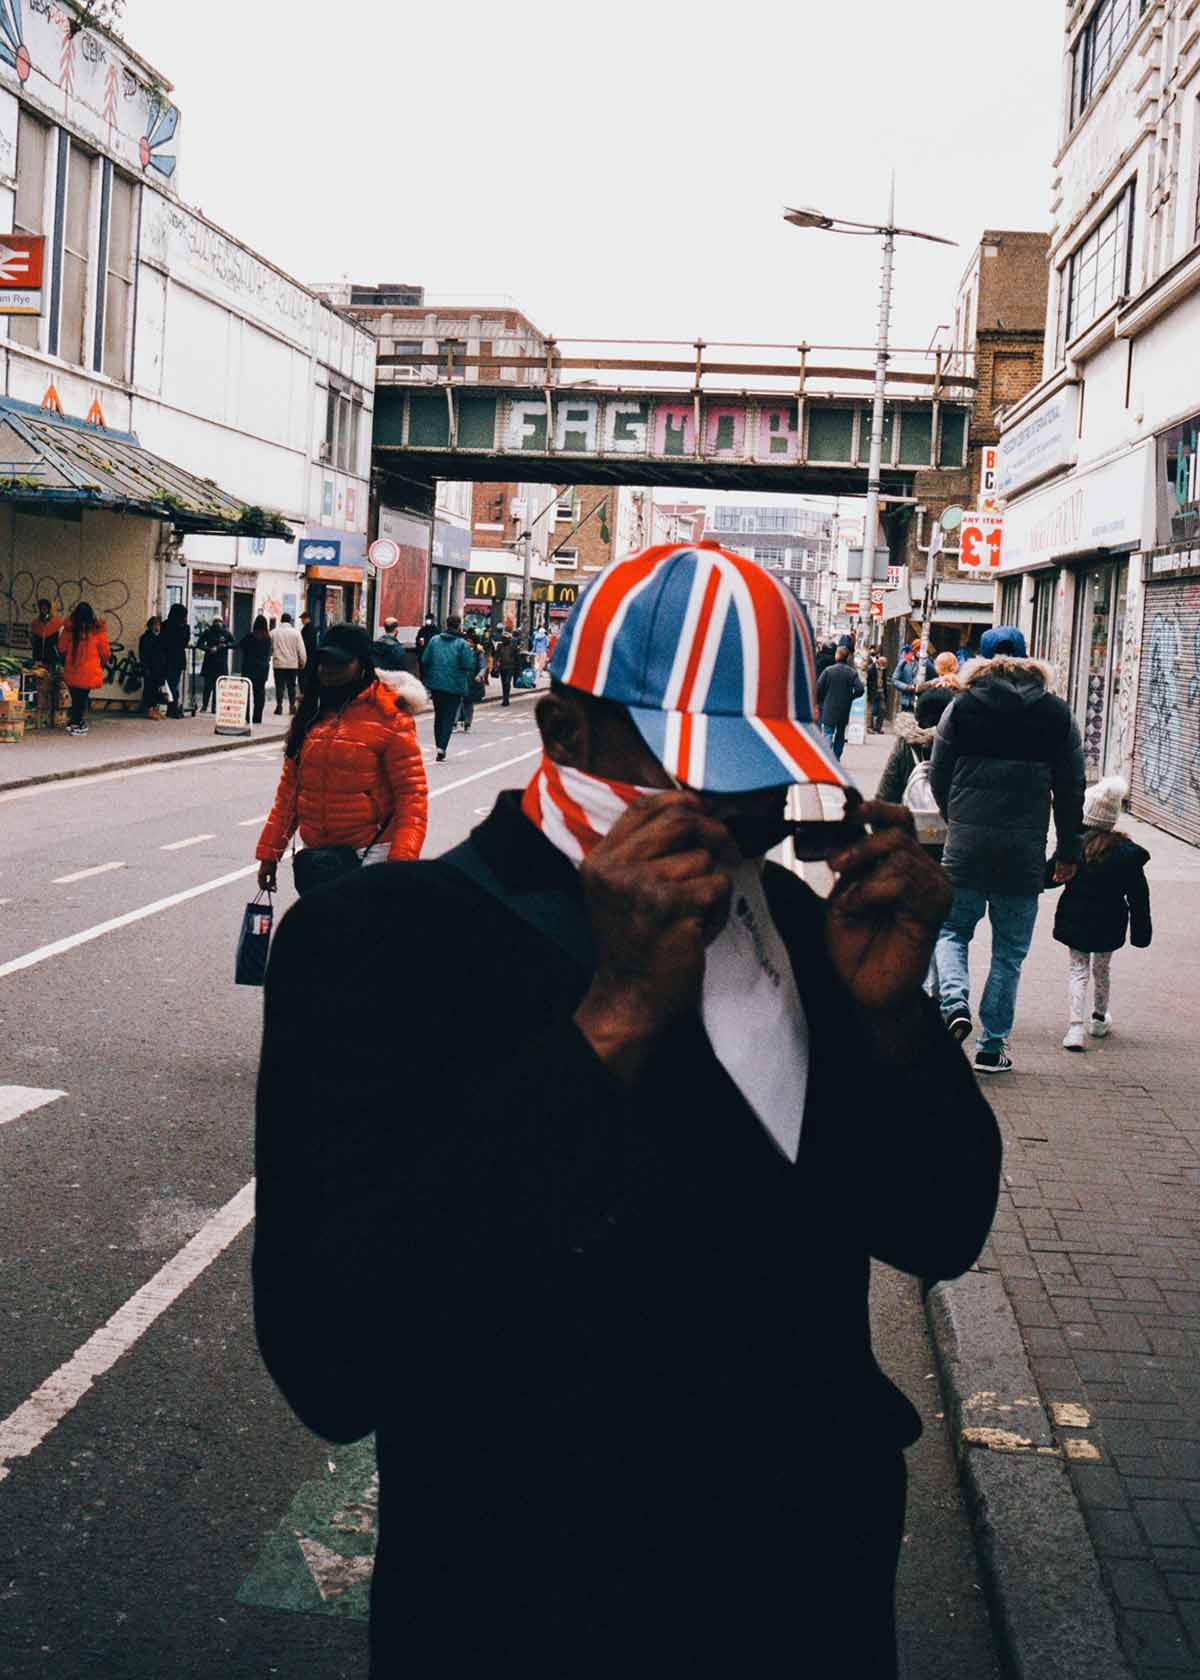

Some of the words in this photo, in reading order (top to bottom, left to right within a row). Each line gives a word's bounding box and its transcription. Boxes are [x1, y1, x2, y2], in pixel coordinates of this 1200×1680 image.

[13, 293, 31, 304] Rye
[983, 517, 1004, 525] ITEM
[961, 527, 1002, 567] £1
